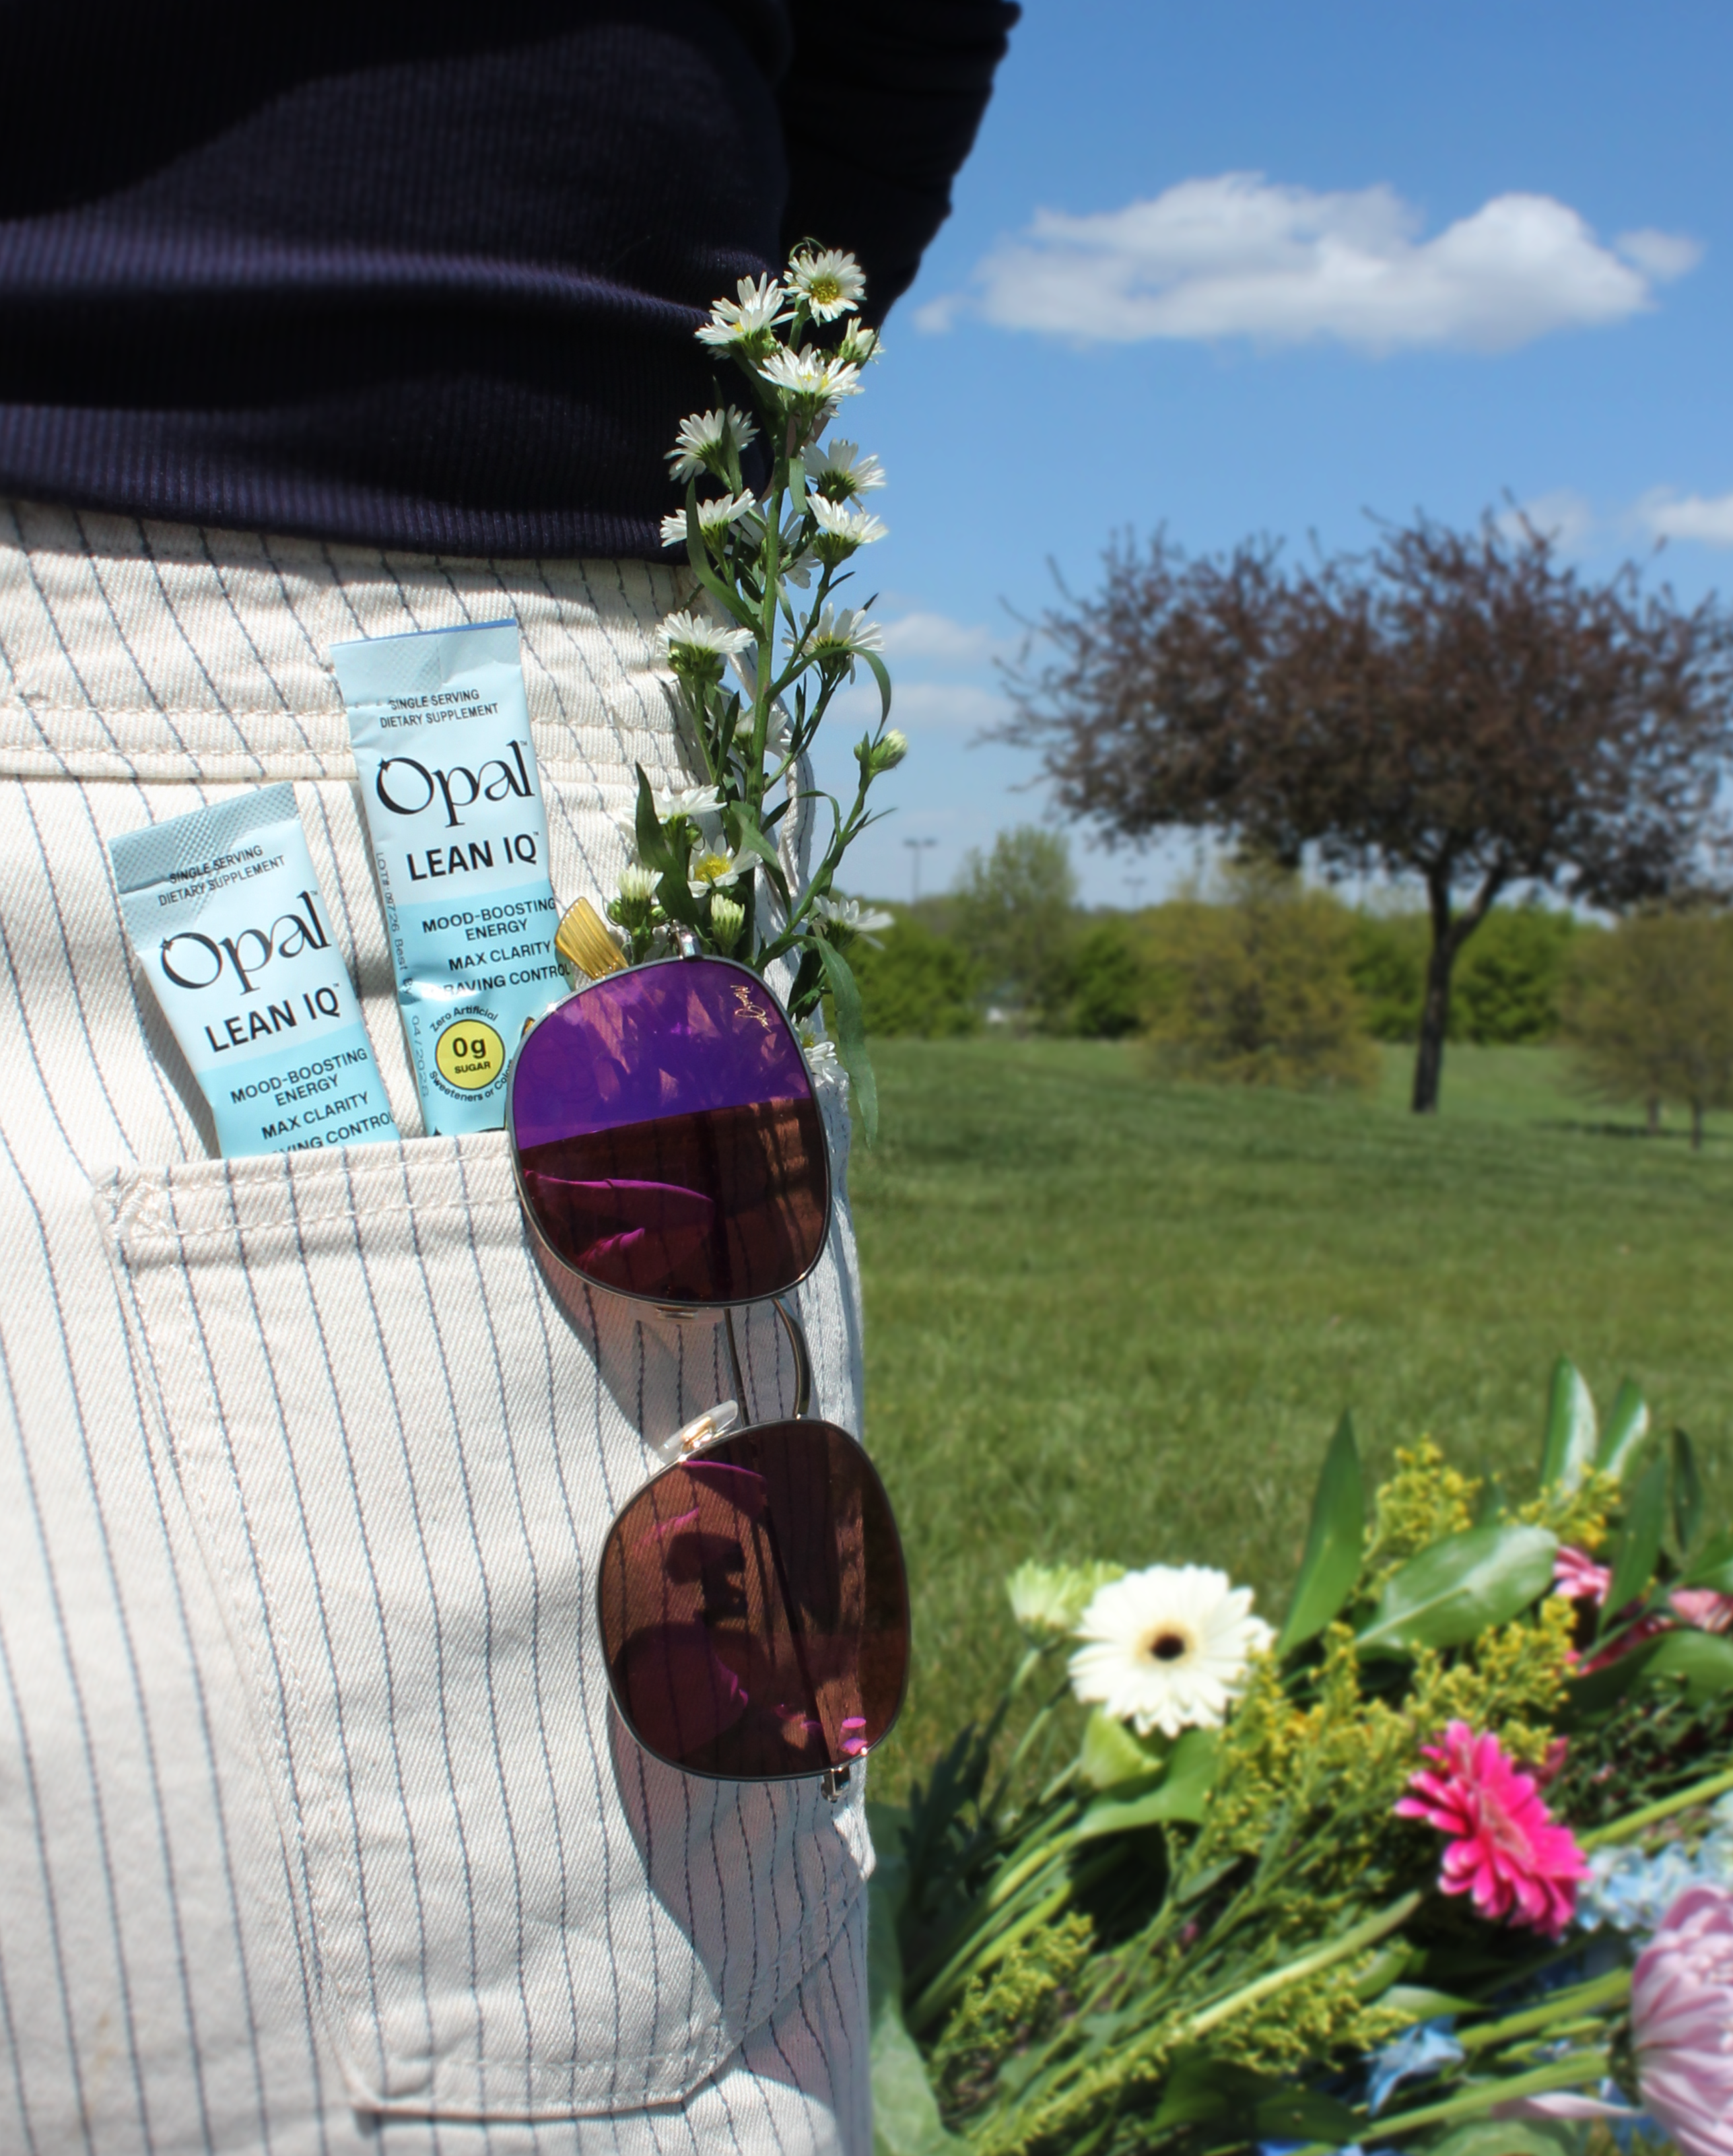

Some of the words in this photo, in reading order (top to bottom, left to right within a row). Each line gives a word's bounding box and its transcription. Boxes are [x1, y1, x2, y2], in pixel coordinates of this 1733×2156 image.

[380, 714, 423, 729] DIETARY
[426, 703, 499, 724] SUPPLEMENT
[389, 696, 428, 710] SINGLE
[431, 689, 480, 706] SERVING
[168, 862, 211, 884] SINGLE
[213, 844, 263, 870] SERVING
[407, 840, 494, 881] LEAN
[158, 881, 205, 907] DIETARY
[208, 854, 286, 891] SUPPLEMENT
[421, 898, 555, 933] MOOD-BOOSTING
[465, 919, 529, 941] ENERGY
[395, 938, 409, 971] Best
[448, 952, 487, 971] MAX
[490, 941, 551, 963] CLARITY
[443, 975, 506, 996] RAVING
[510, 964, 570, 984] CONTROL
[205, 999, 298, 1052] LEAN
[430, 1012, 452, 1033] Zero
[454, 1005, 499, 1022] Artificial
[230, 1047, 368, 1104] MOOD-BOOSTING
[454, 1060, 491, 1075] SUGAR
[274, 1074, 339, 1107] ENERGY
[429, 1070, 483, 1102] Sweeteners
[485, 1088, 494, 1098] or
[261, 1115, 302, 1141] MAX
[303, 1091, 369, 1124] CLARITY
